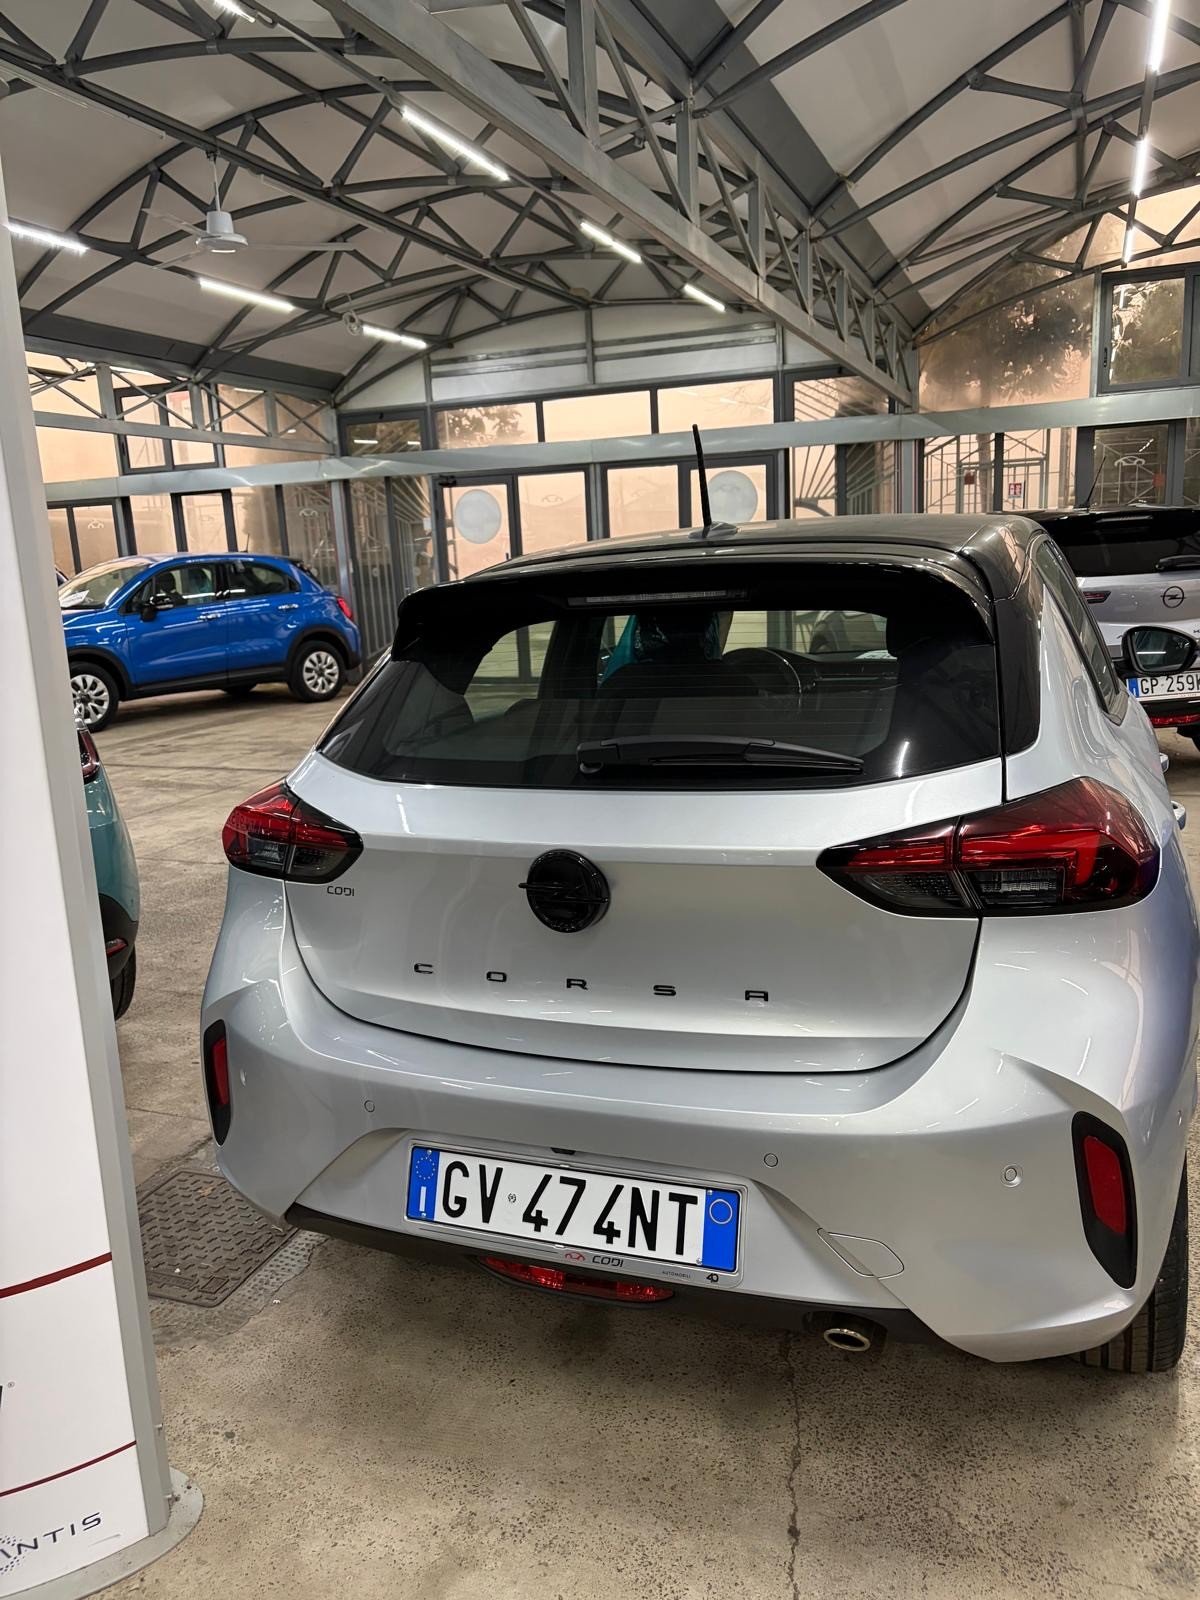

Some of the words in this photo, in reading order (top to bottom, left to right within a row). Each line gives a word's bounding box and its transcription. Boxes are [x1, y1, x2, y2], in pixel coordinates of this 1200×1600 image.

[1140, 677, 1159, 694] GP
[326, 885, 355, 897] CODI
[413, 962, 769, 1002] CORSA
[442, 1160, 503, 1224] GV
[522, 1174, 699, 1256] 474NT
[592, 1254, 624, 1268] CODI
